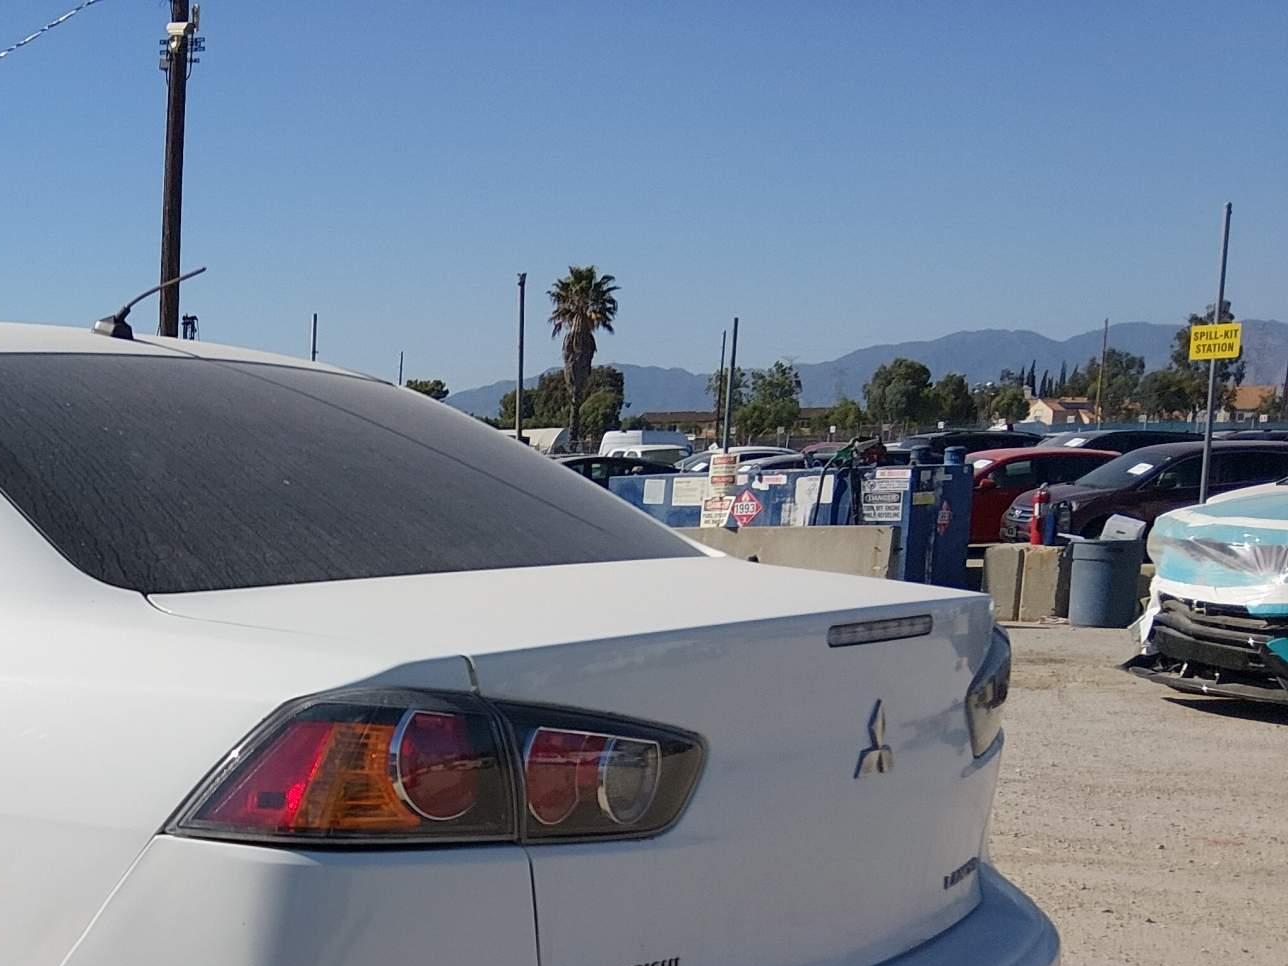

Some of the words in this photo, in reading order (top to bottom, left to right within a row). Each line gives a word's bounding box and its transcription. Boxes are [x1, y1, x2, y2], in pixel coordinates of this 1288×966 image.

[1193, 329, 1239, 341] SPILL-KIT
[1195, 342, 1234, 354] STATION
[735, 503, 755, 514] 1993
